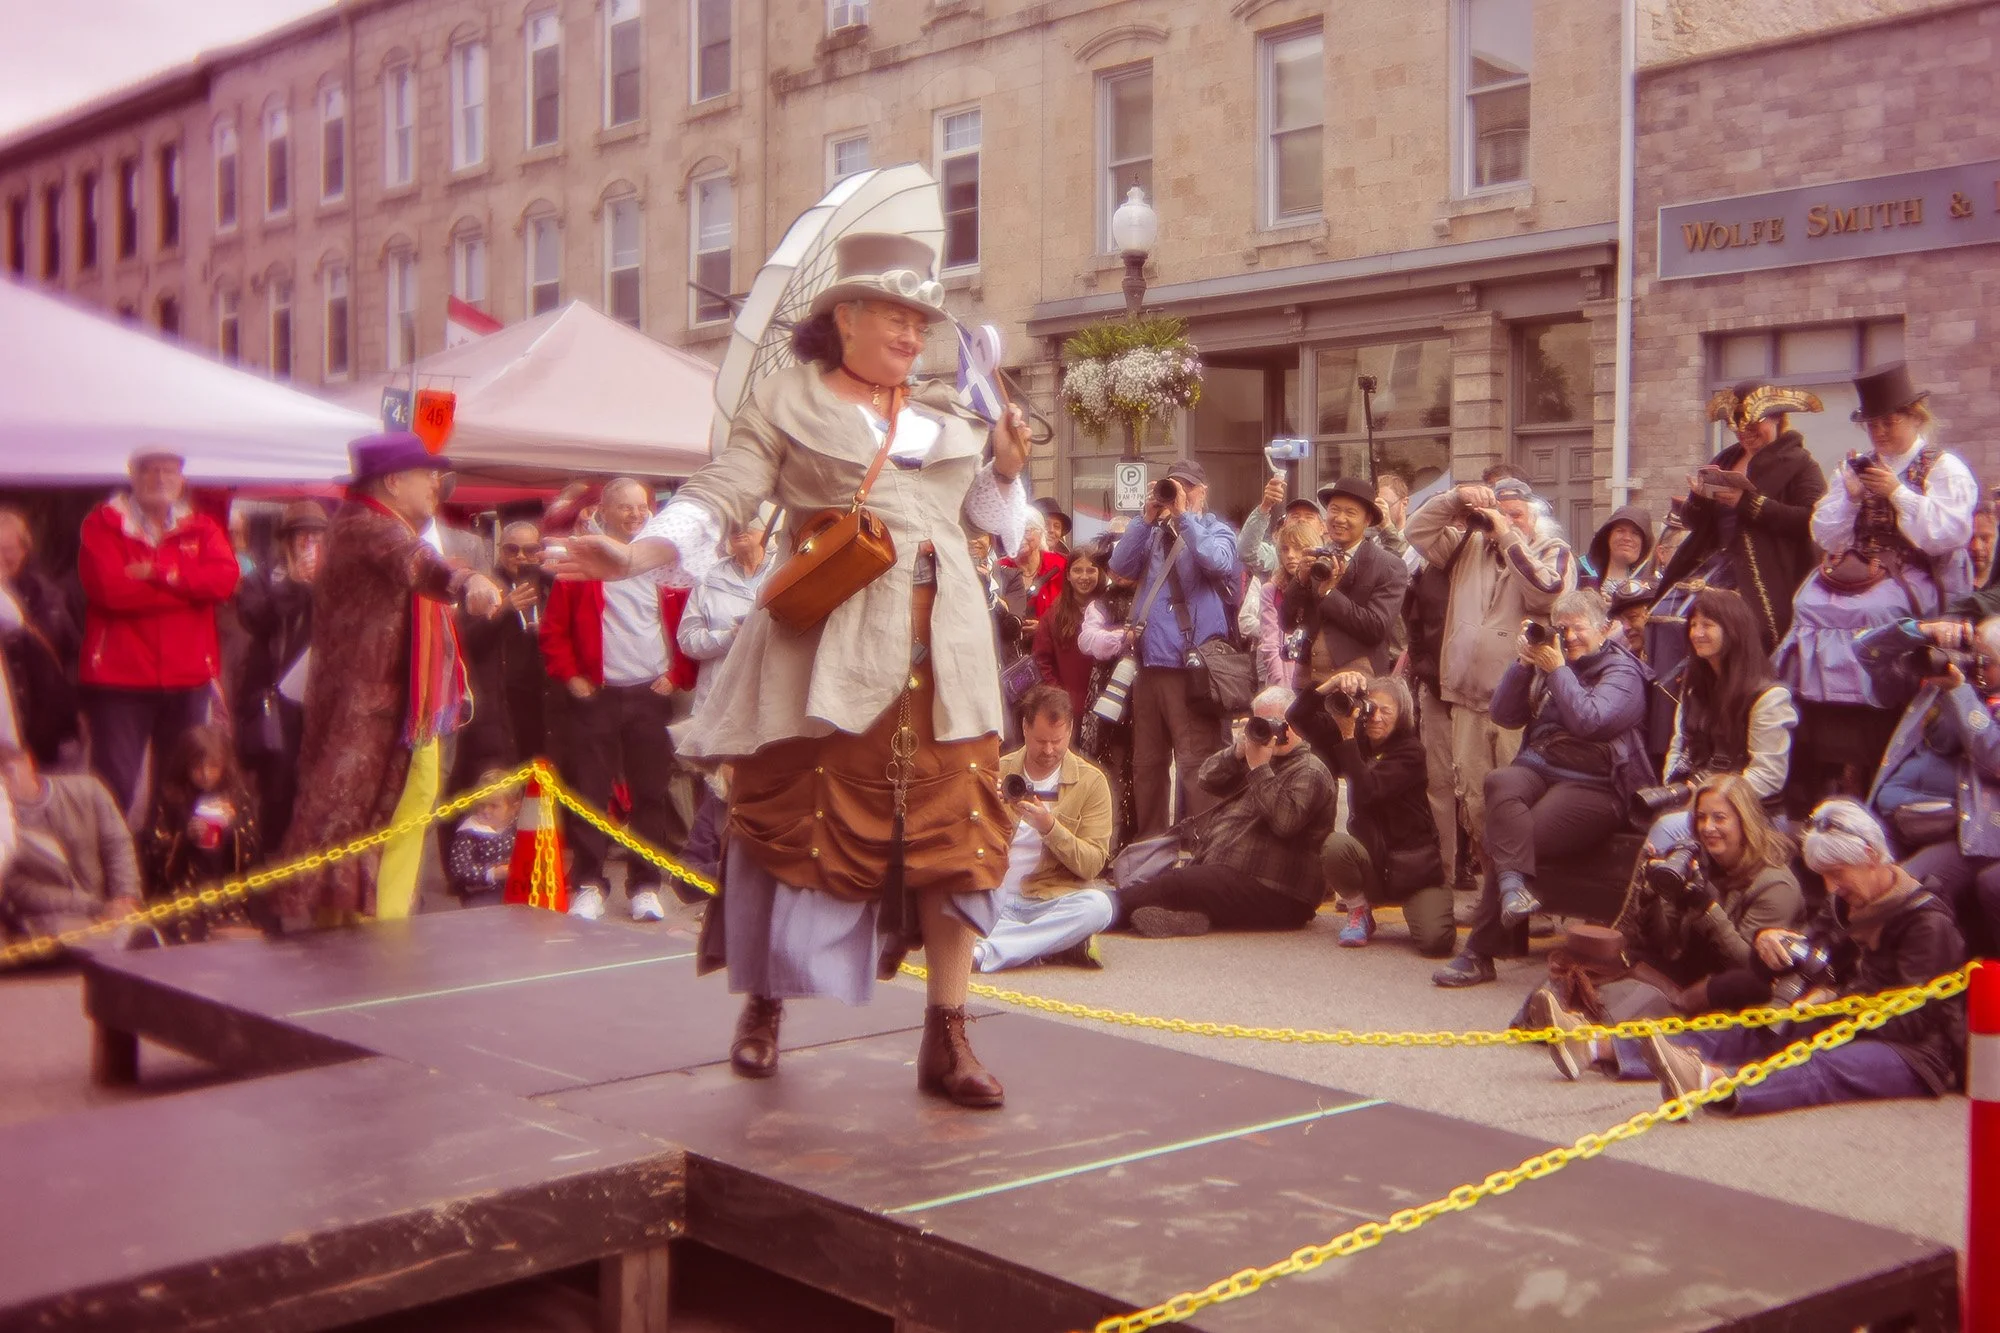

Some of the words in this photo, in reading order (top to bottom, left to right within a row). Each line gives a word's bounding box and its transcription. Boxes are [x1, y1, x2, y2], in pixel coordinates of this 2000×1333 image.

[1680, 217, 1784, 252] WOLFE
[1807, 197, 1924, 238] SMITH
[1949, 191, 1974, 219] &
[1127, 471, 1136, 481] P
